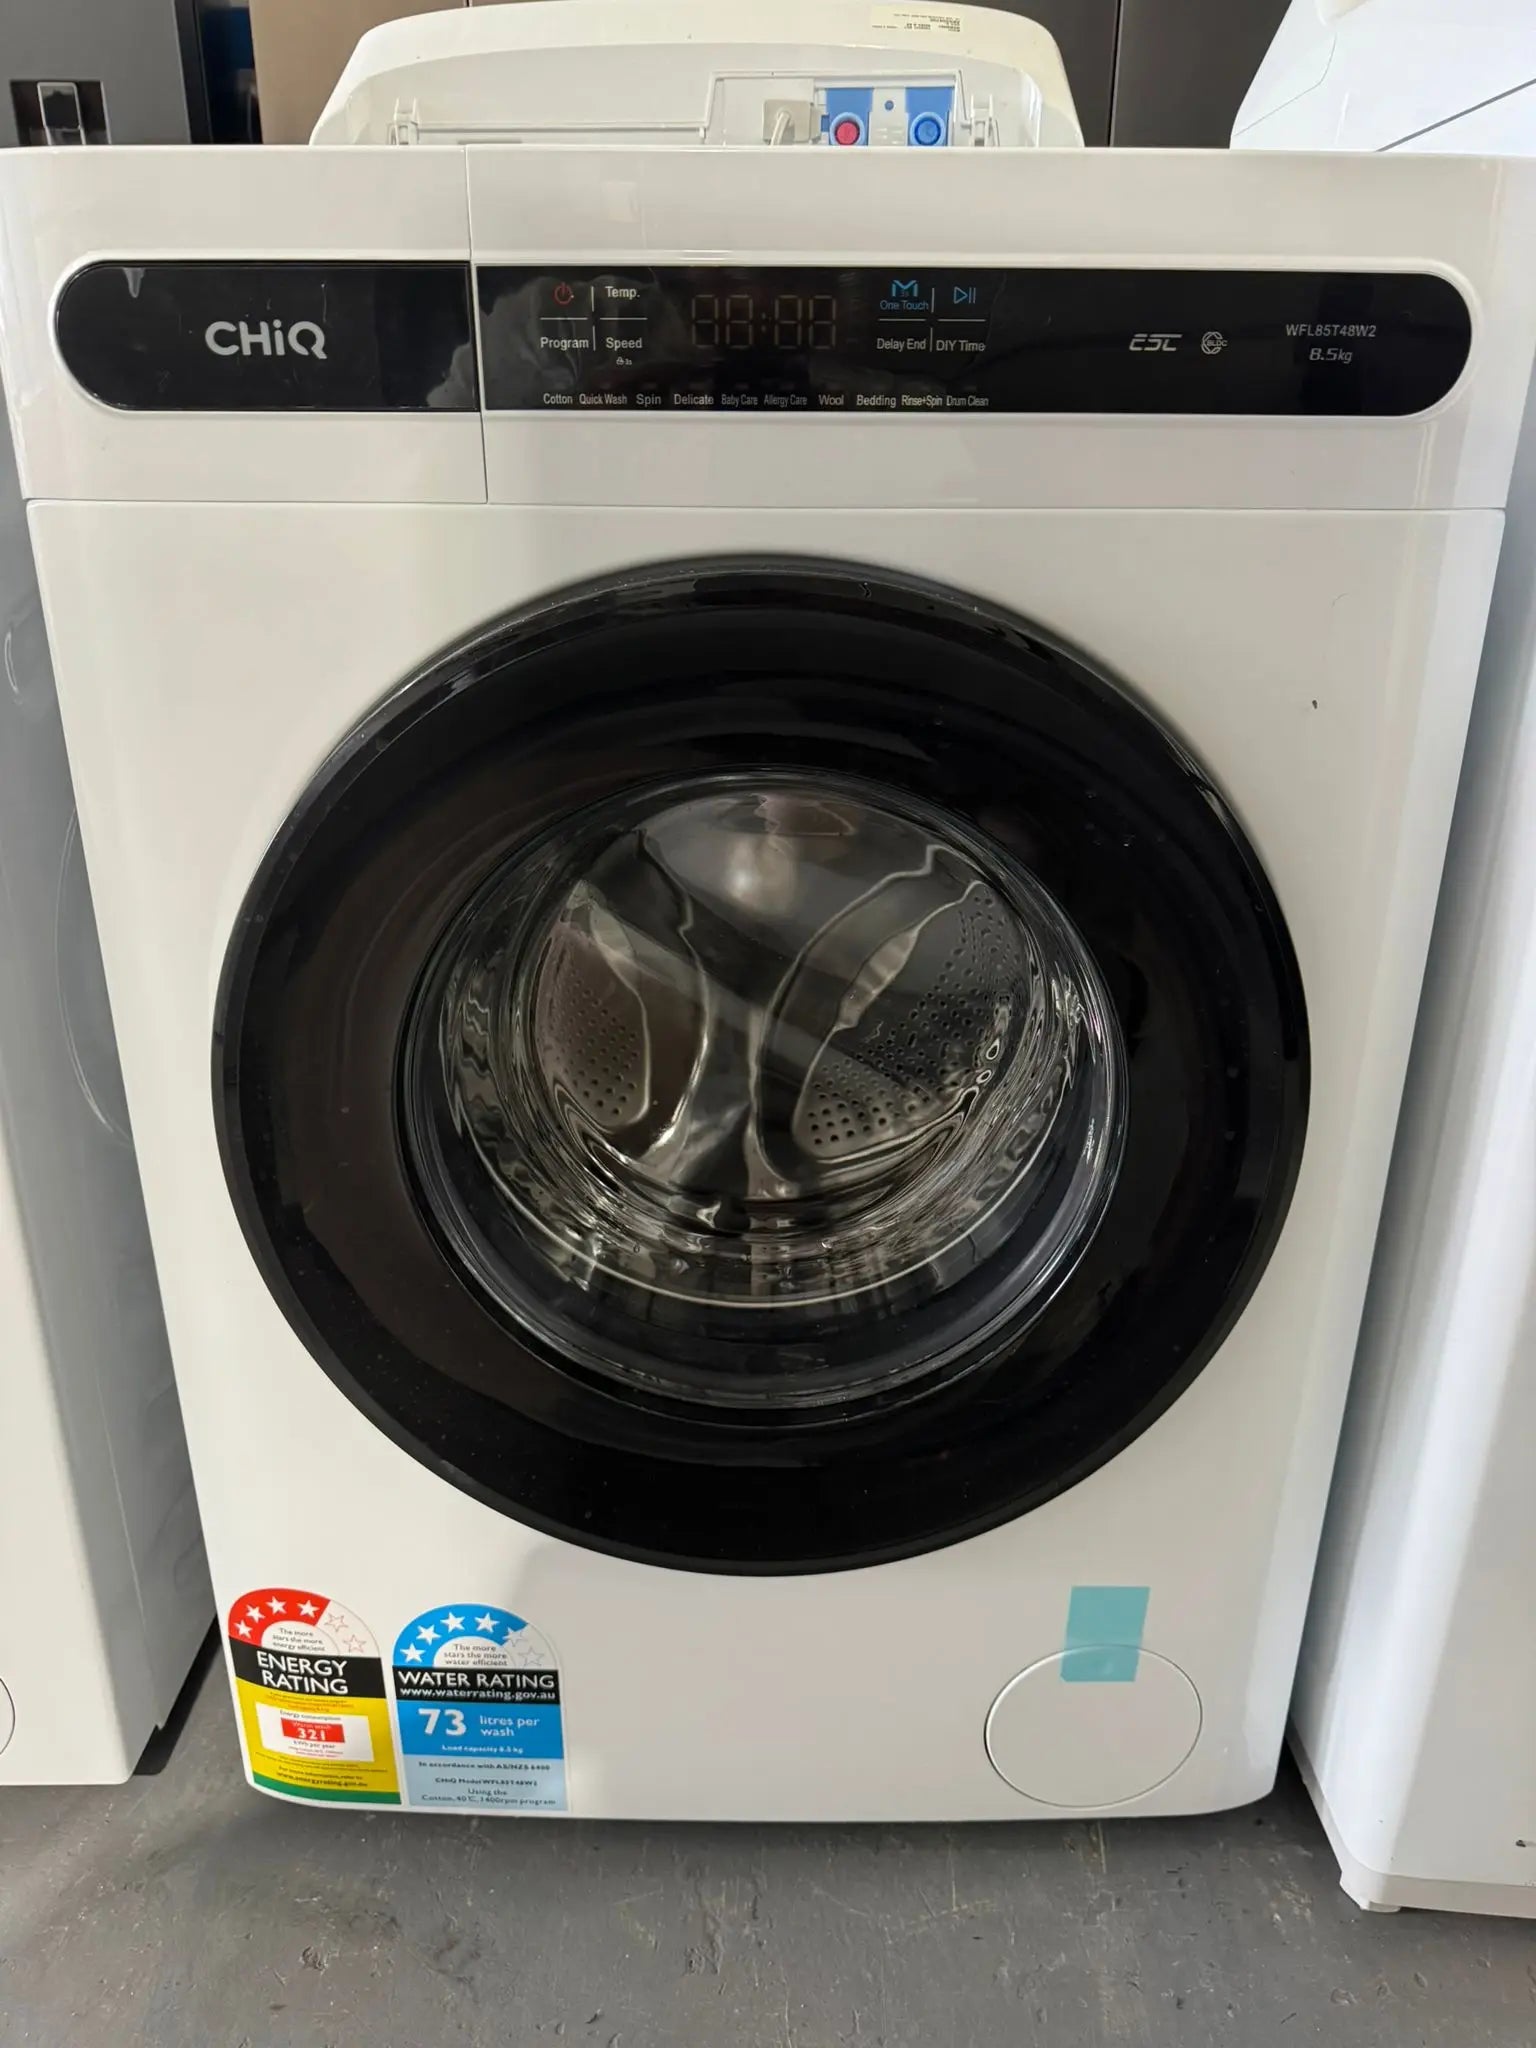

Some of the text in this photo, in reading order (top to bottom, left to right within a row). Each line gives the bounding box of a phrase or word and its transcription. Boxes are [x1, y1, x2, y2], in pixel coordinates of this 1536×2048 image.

[605, 286, 640, 300] Temp.
[880, 300, 929, 311] One Touch
[1286, 324, 1377, 338] WFL85T48W2
[204, 319, 328, 359] CHiQ
[540, 336, 589, 351] Program
[605, 337, 643, 351] Speed
[876, 337, 927, 352] Delay End
[936, 339, 986, 352] DIY Time
[543, 392, 573, 405] Cotton
[578, 393, 628, 405] Quick Wash
[636, 393, 662, 407] Spin
[674, 393, 714, 405] Delicate
[721, 394, 758, 407] Baby Care
[763, 394, 807, 408] Allergy Care
[818, 394, 845, 406] Wool
[856, 394, 897, 408] Bedding
[901, 394, 943, 409] Rinse+Spin
[946, 395, 989, 407] Drum Clean
[272, 1634, 289, 1642] stars
[279, 1627, 293, 1635] The
[272, 1641, 296, 1651] energy
[454, 1643, 470, 1651] The
[256, 1650, 348, 1677] ENERGY
[472, 1658, 508, 1667] efficient
[261, 1669, 349, 1695] RATING
[398, 1671, 555, 1689] WATER RATING
[400, 1687, 555, 1702] www.waterrating.gov.au
[418, 1707, 467, 1736] 73
[479, 1714, 540, 1729] litres per
[297, 1727, 326, 1741] 321
[479, 1727, 515, 1737] wash
[468, 1788, 492, 1797] Using
